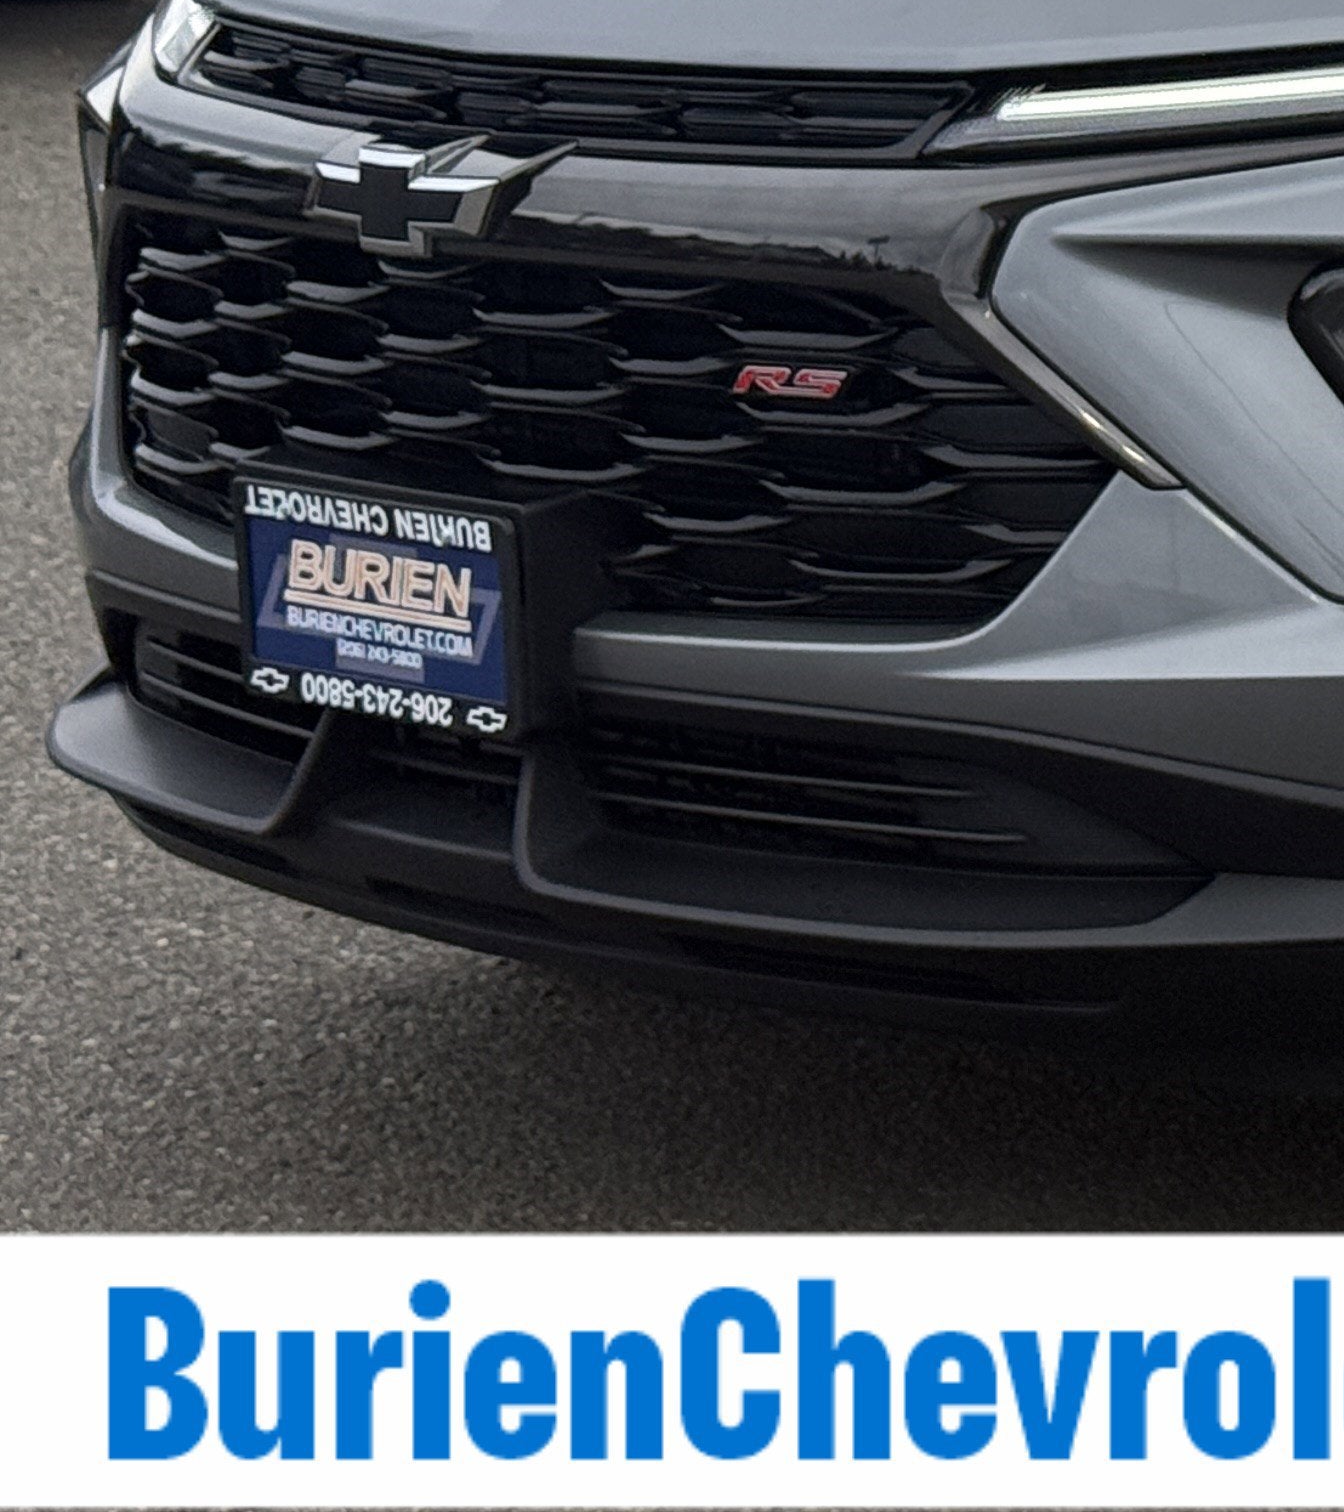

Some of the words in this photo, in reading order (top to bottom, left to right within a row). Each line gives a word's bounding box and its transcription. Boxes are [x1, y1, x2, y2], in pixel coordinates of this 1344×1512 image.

[732, 364, 848, 399] RS
[245, 484, 389, 536] CHEVROLET
[394, 507, 491, 552] BURIEN
[288, 538, 472, 618] BURIEN
[286, 605, 474, 658] BURIENCHEVROLET.COM
[300, 672, 453, 727] 206-243-5800
